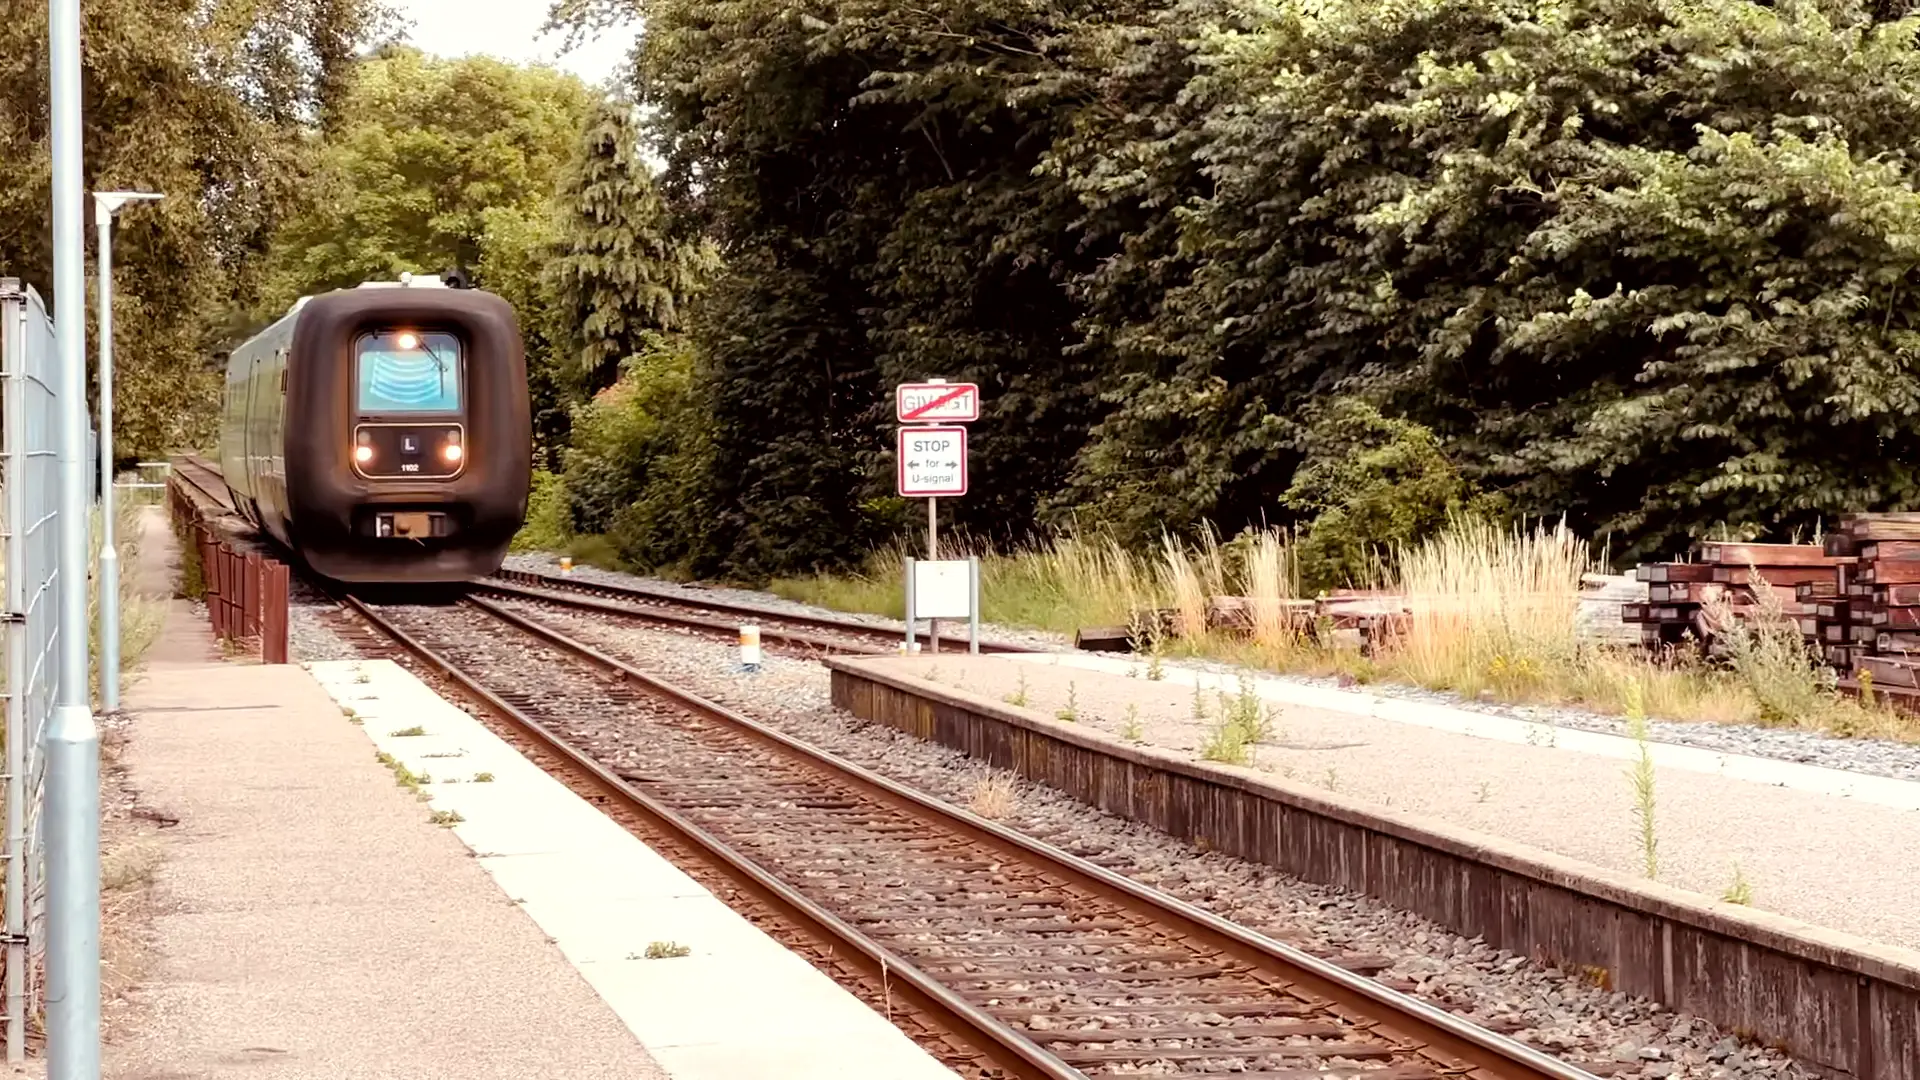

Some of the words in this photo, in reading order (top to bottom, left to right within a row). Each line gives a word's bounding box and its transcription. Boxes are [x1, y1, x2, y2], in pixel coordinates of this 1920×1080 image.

[405, 438, 415, 450] L
[914, 440, 950, 452] STOP
[926, 459, 939, 468] for
[912, 474, 953, 484] U-signal
